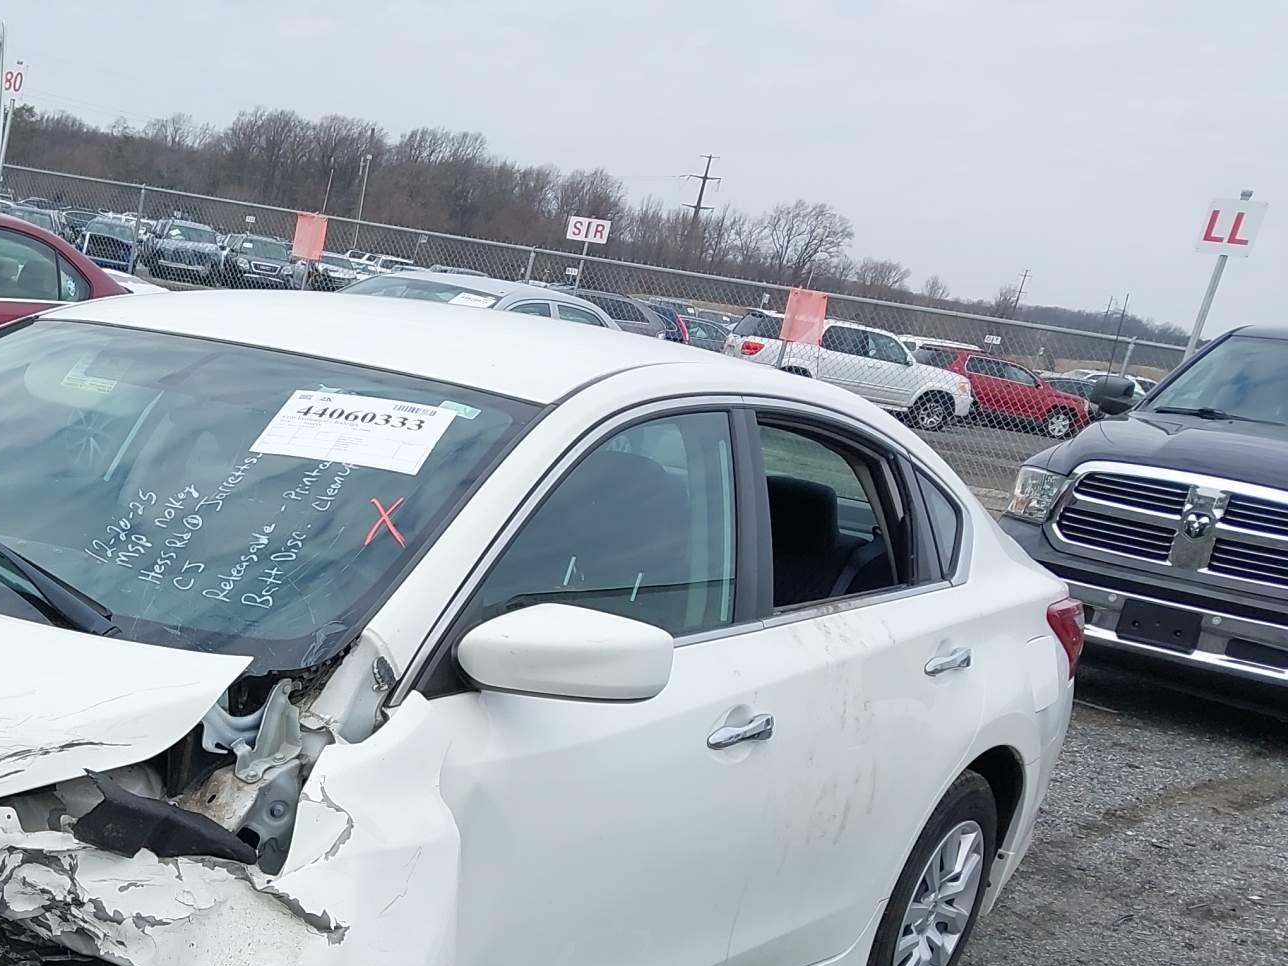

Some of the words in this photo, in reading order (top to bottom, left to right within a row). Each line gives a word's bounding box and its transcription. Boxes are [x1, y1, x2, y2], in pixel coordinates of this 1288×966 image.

[5, 71, 23, 92] 80
[1202, 209, 1249, 246] LL
[296, 405, 425, 432] 44060333
[138, 550, 177, 584] Hess
